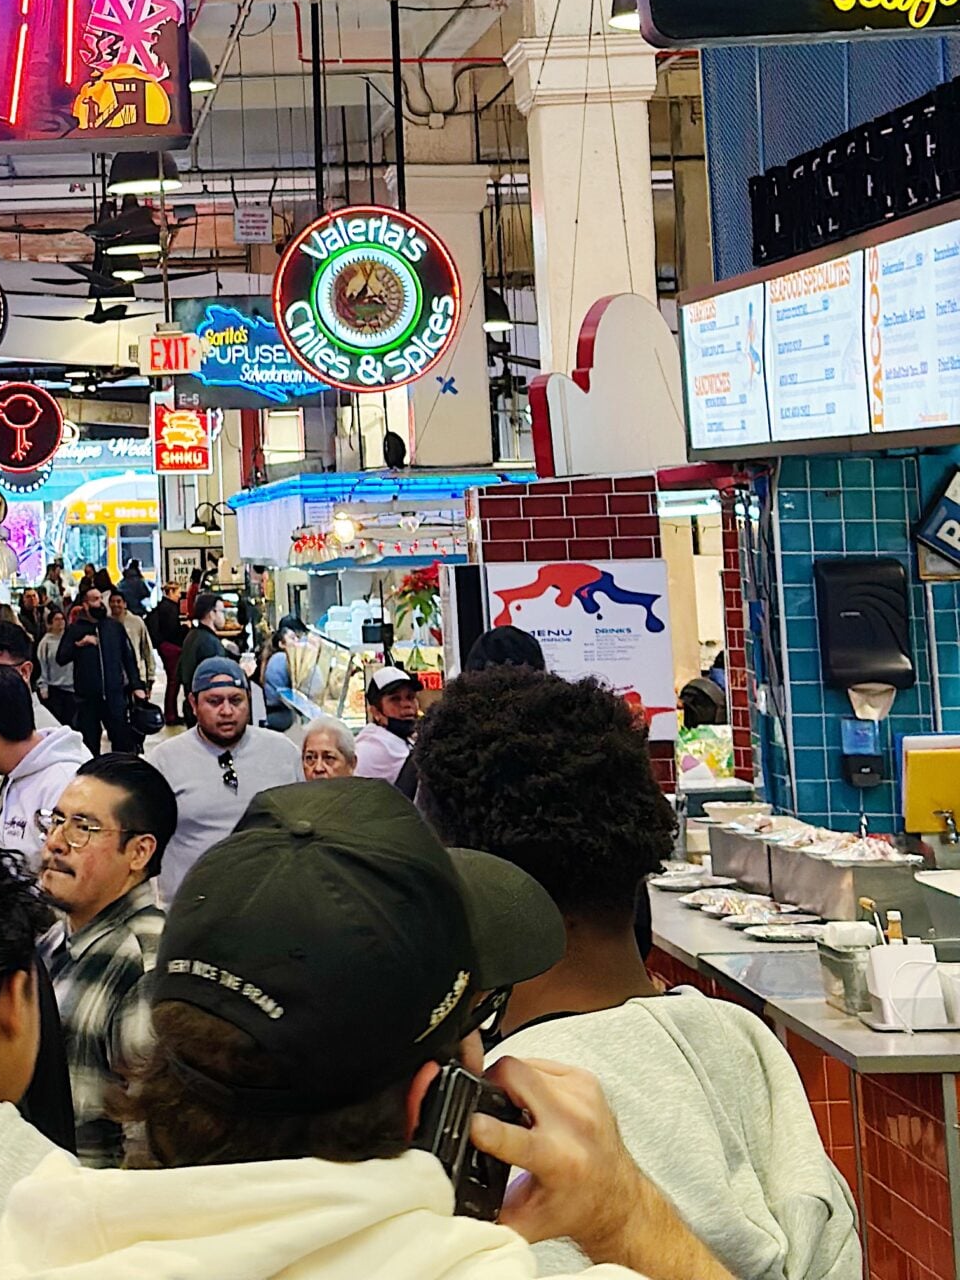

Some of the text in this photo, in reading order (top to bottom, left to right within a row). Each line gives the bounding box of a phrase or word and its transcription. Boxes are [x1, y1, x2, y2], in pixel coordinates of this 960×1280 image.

[299, 215, 428, 262] Valeria's
[150, 336, 190, 371] EXIT
[202, 344, 292, 365] PUPUSE
[285, 294, 455, 386] Chiles & Spices
[868, 246, 884, 432] TACOS
[161, 451, 204, 466] SHIKU
